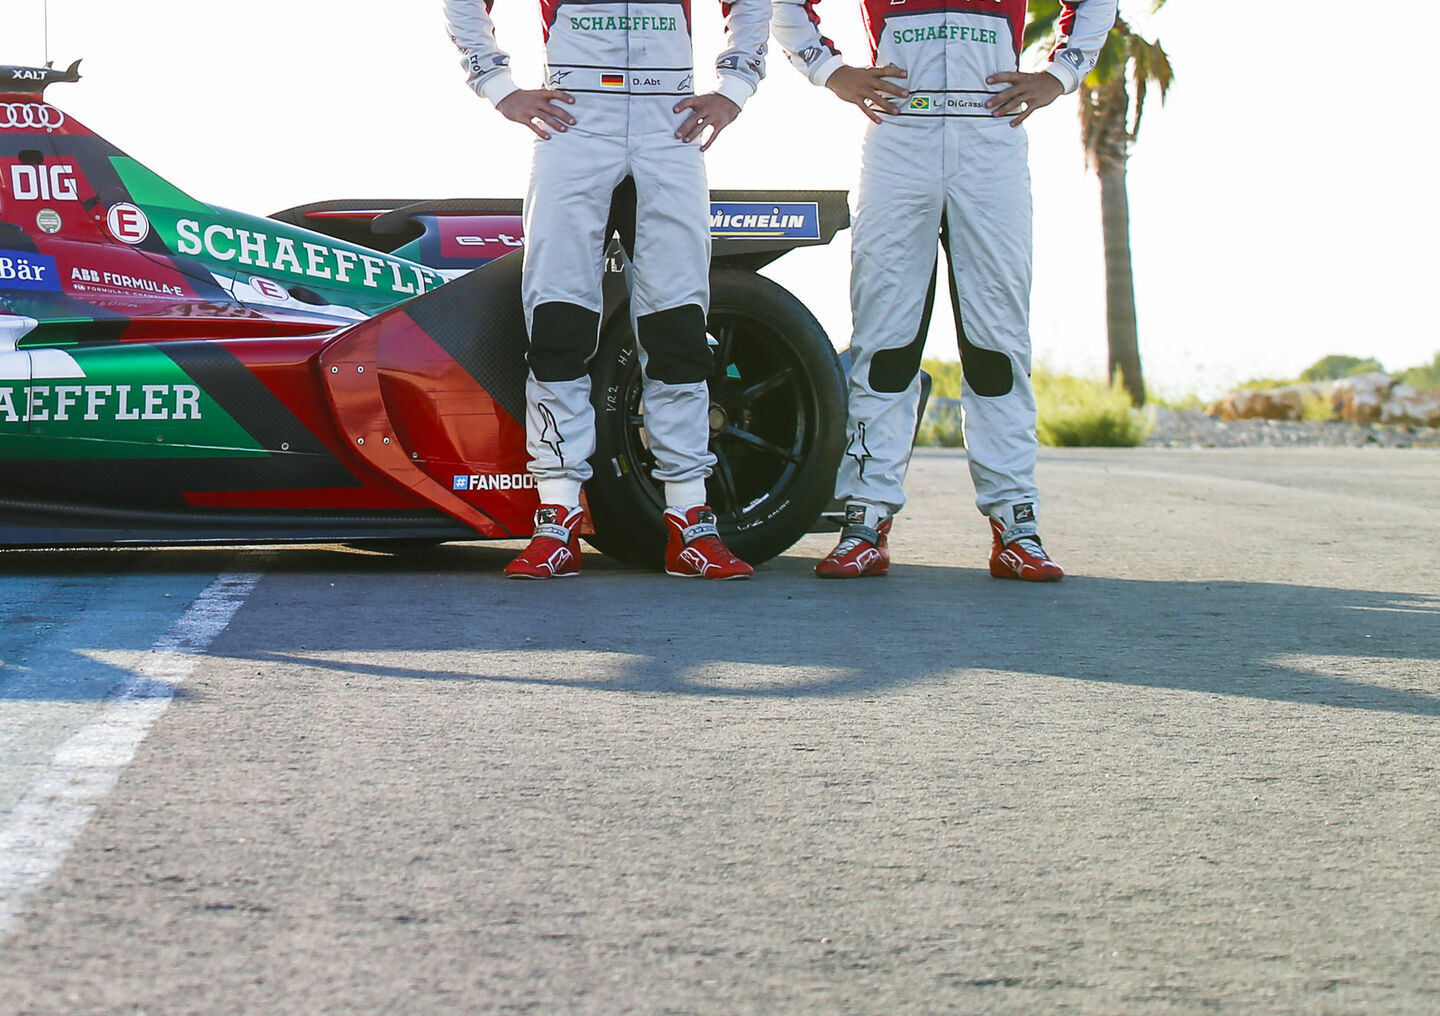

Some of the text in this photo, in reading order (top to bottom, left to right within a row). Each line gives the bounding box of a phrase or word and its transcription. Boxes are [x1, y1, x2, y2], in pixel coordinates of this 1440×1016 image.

[571, 16, 677, 31] SCHAEFFLER
[894, 26, 998, 44] SCHAEFFLER
[12, 69, 48, 81] XALT
[632, 78, 661, 86] D. Abt
[11, 164, 78, 201] DIG
[118, 209, 140, 237] E
[709, 215, 805, 228] MICHELIN
[456, 233, 524, 247] e-t
[176, 218, 455, 295] SCHAEFFLE
[71, 267, 100, 283] ABB
[259, 281, 281, 299] E
